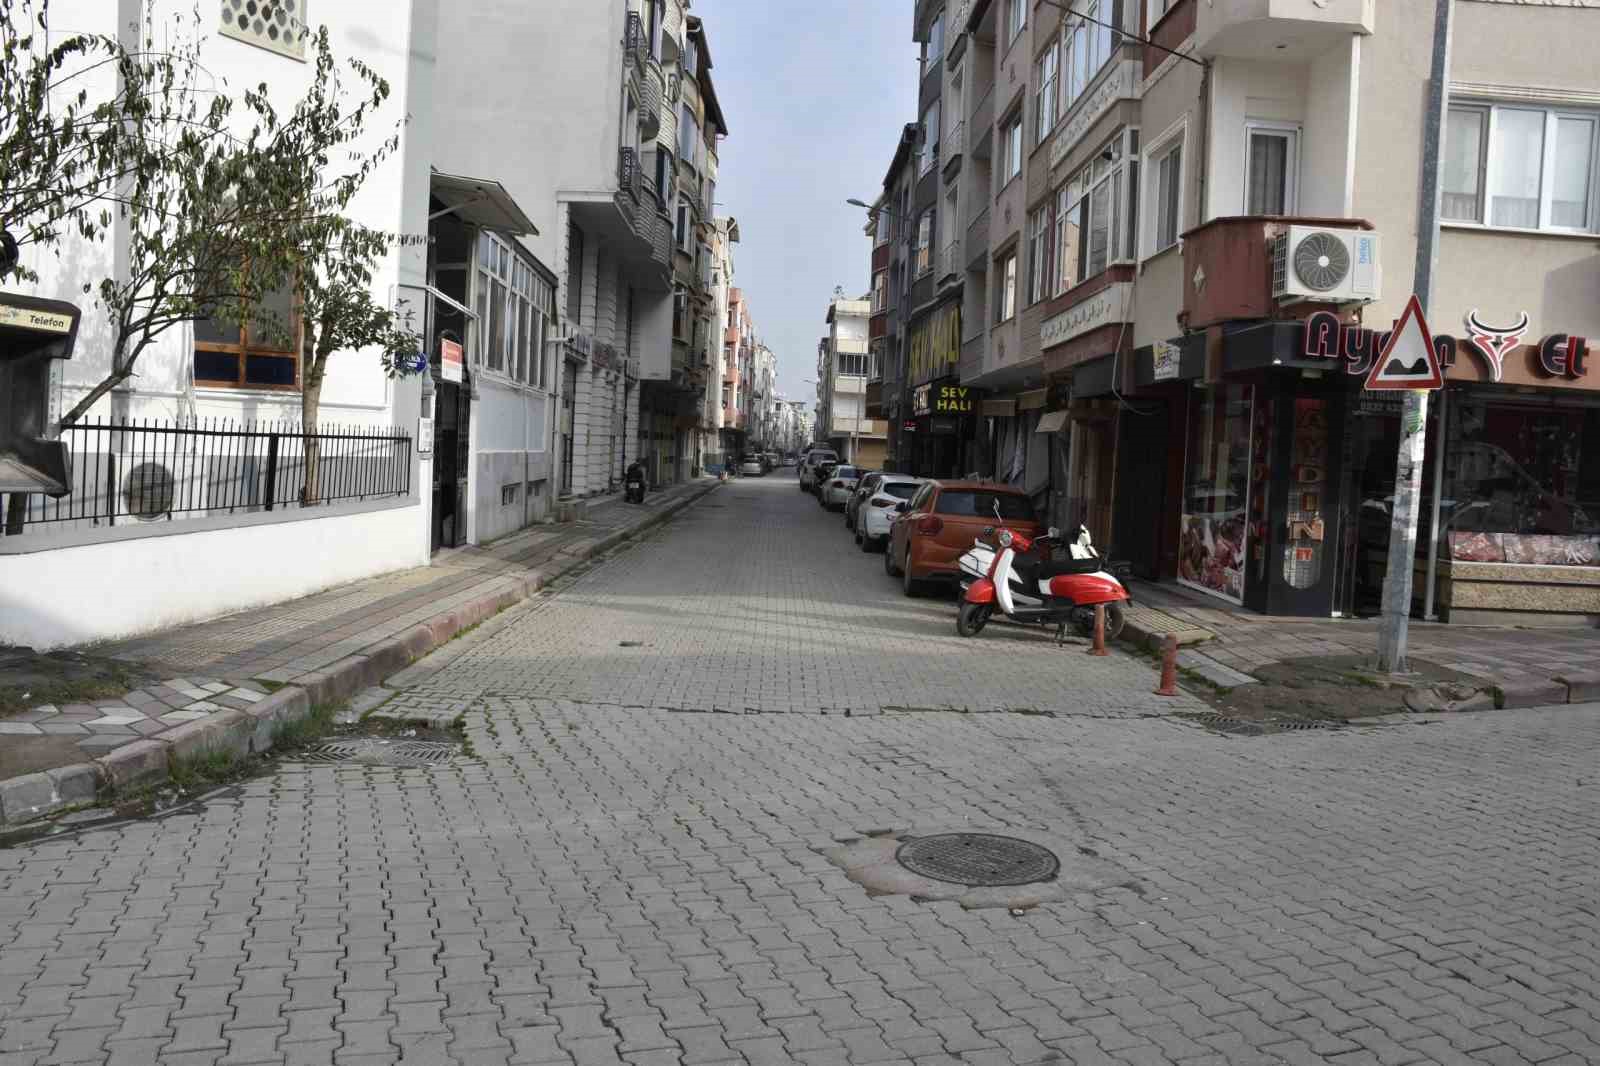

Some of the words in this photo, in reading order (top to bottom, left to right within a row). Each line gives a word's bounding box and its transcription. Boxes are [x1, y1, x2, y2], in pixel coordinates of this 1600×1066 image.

[30, 314, 64, 328] Telefon
[1539, 334, 1589, 378] Et
[940, 386, 968, 398] SEV
[937, 399, 972, 411] HALI
